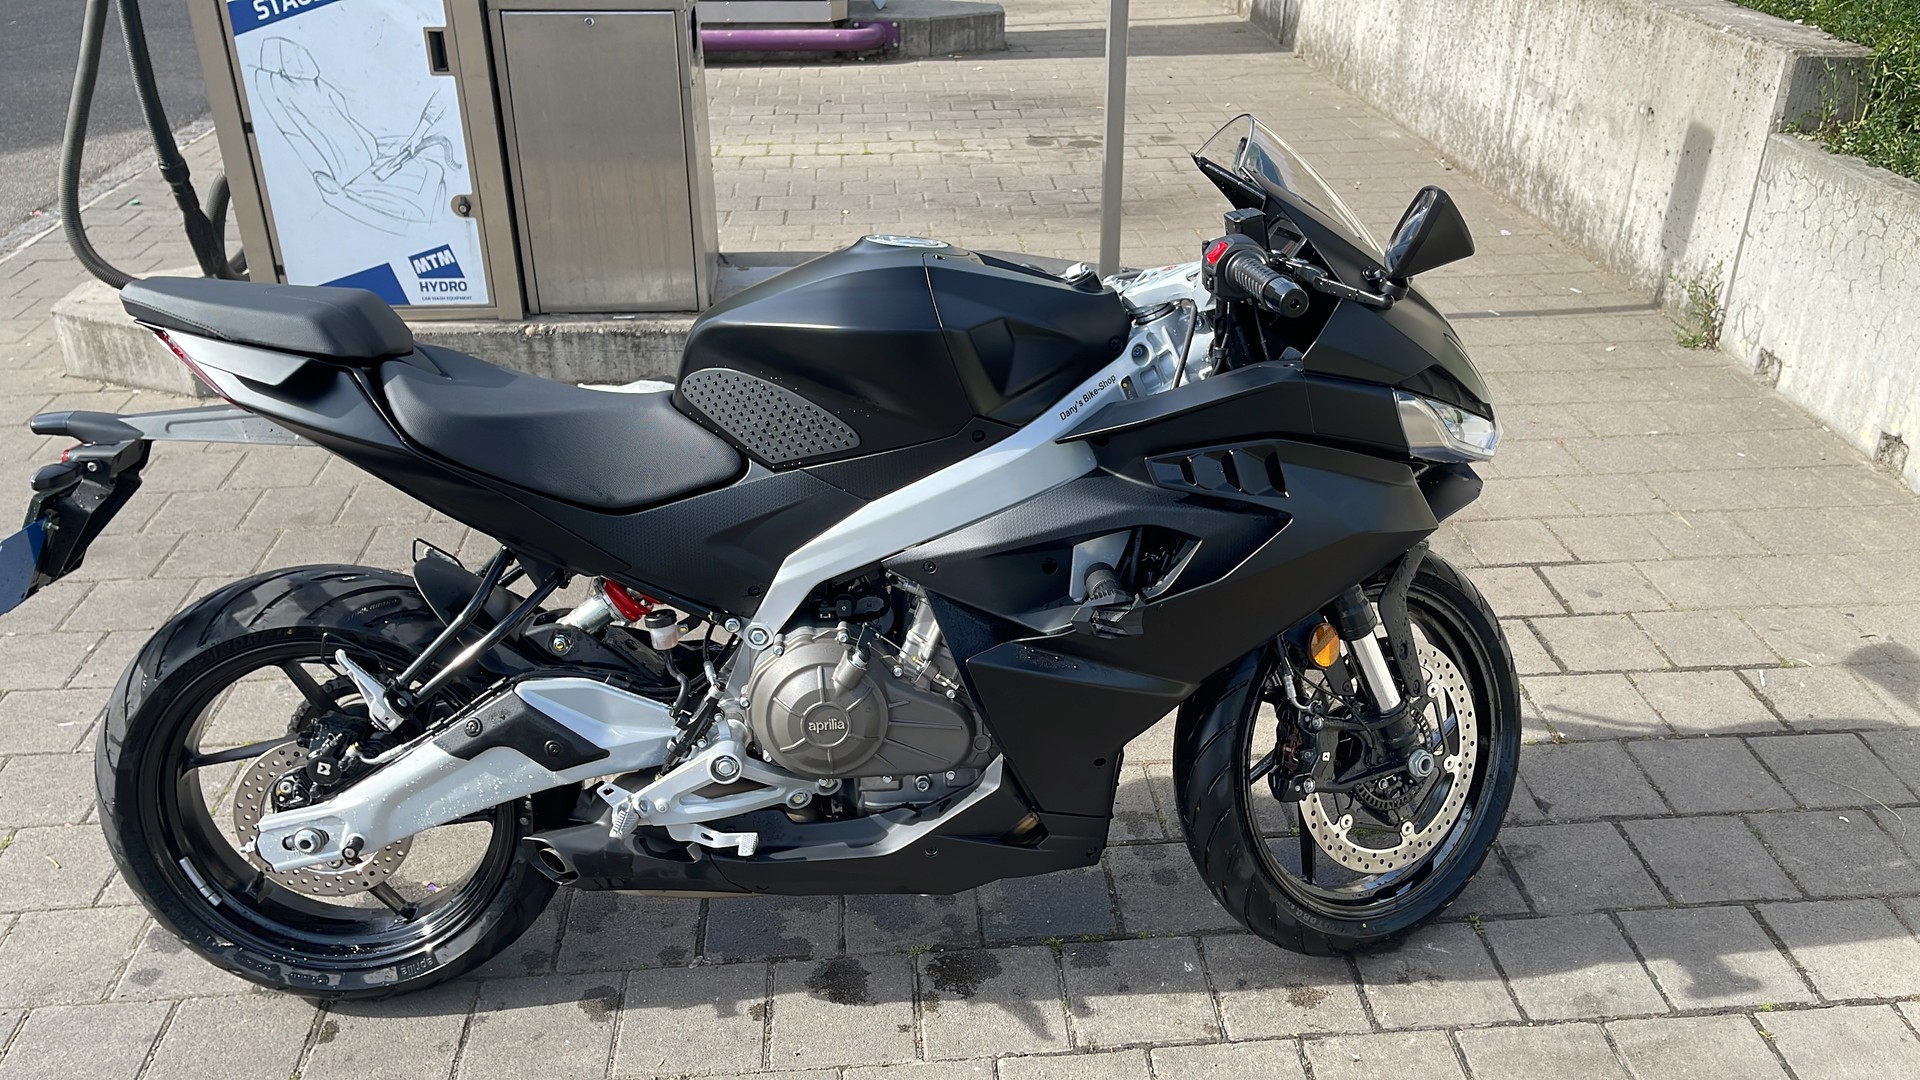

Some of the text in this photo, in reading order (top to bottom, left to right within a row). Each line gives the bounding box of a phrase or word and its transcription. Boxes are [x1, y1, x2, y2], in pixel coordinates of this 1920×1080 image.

[253, 0, 320, 20] STA
[413, 249, 455, 274] MTM
[419, 281, 468, 292] HYDRO
[1060, 374, 1116, 421] Dany's Bike-Shop
[808, 718, 845, 734] aprilia
